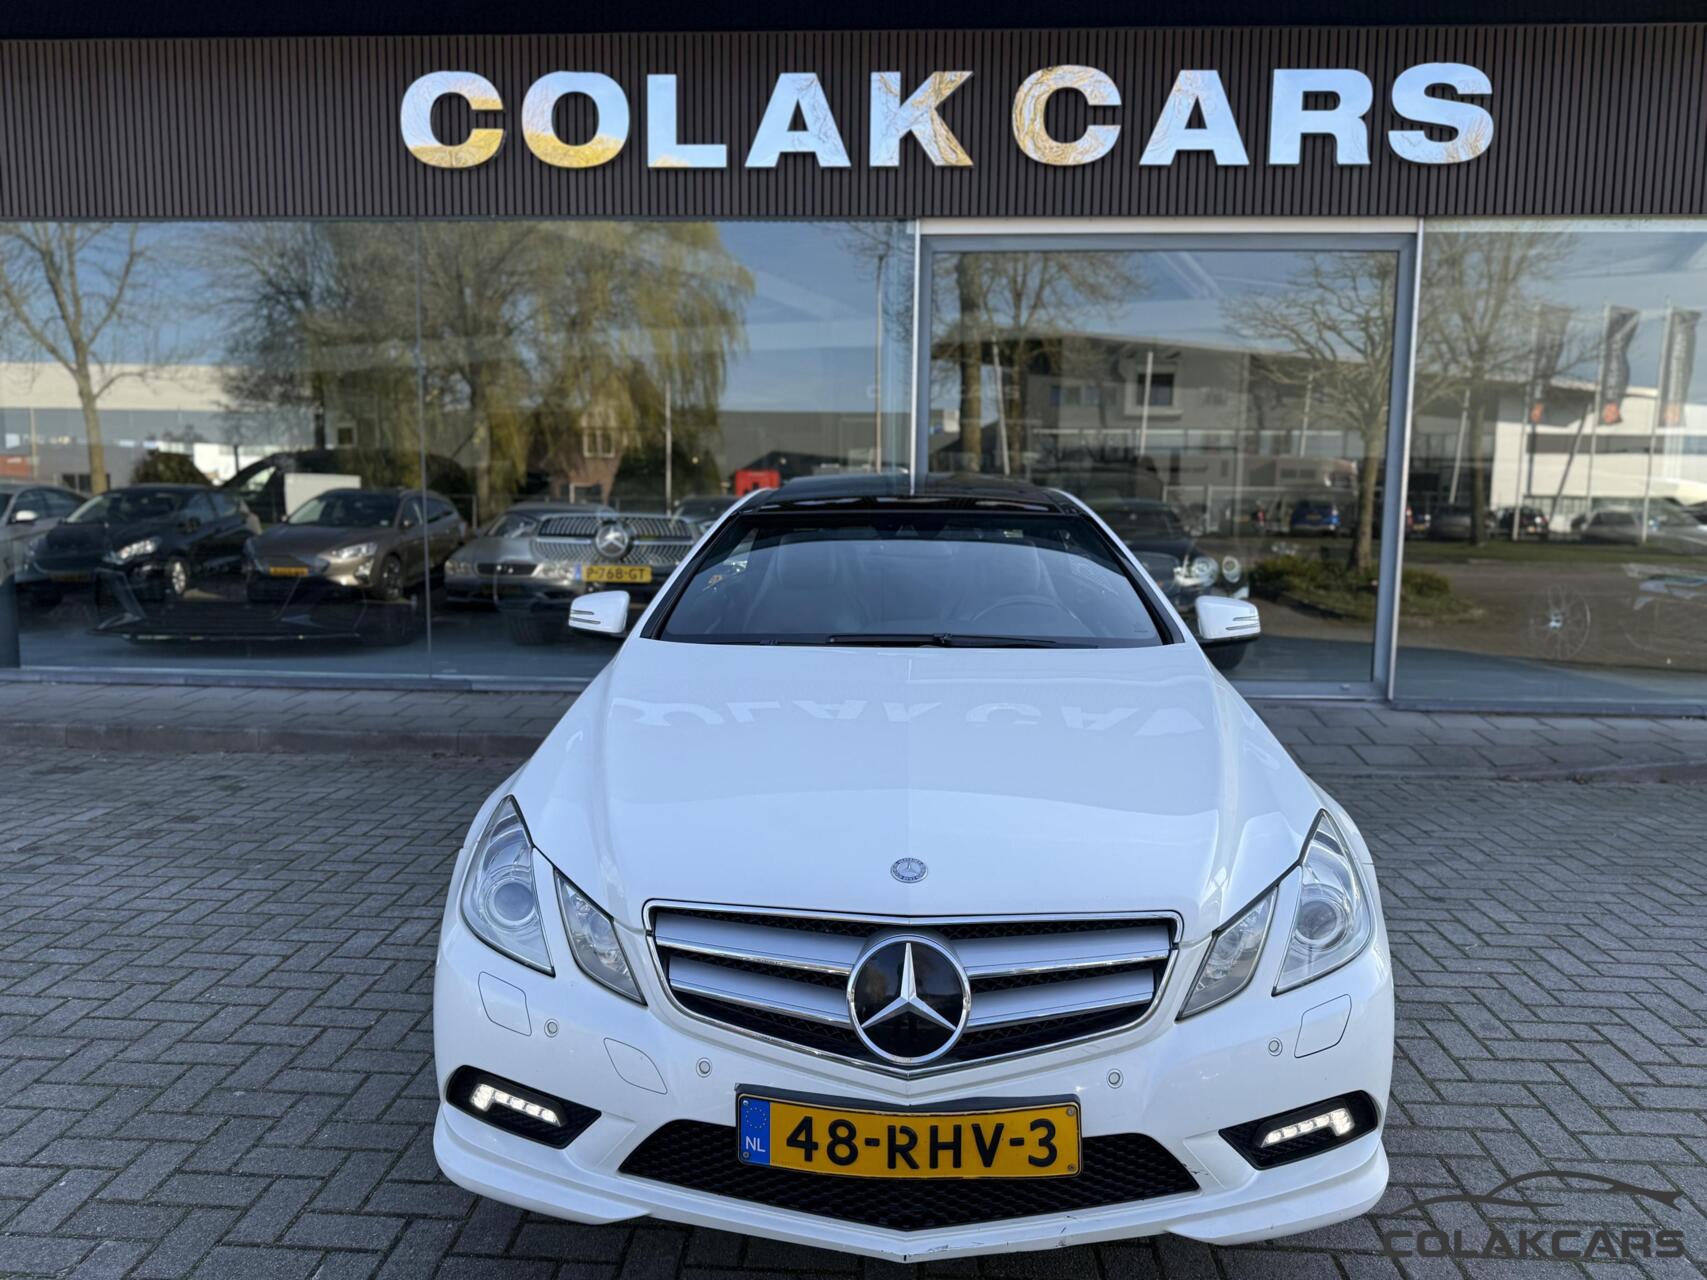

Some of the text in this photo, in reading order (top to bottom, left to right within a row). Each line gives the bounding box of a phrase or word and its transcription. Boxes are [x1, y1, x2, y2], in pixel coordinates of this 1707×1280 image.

[400, 62, 1494, 169] COLAK CARS
[746, 1136, 766, 1153] NL
[786, 1116, 1058, 1169] 48-RHV-3
